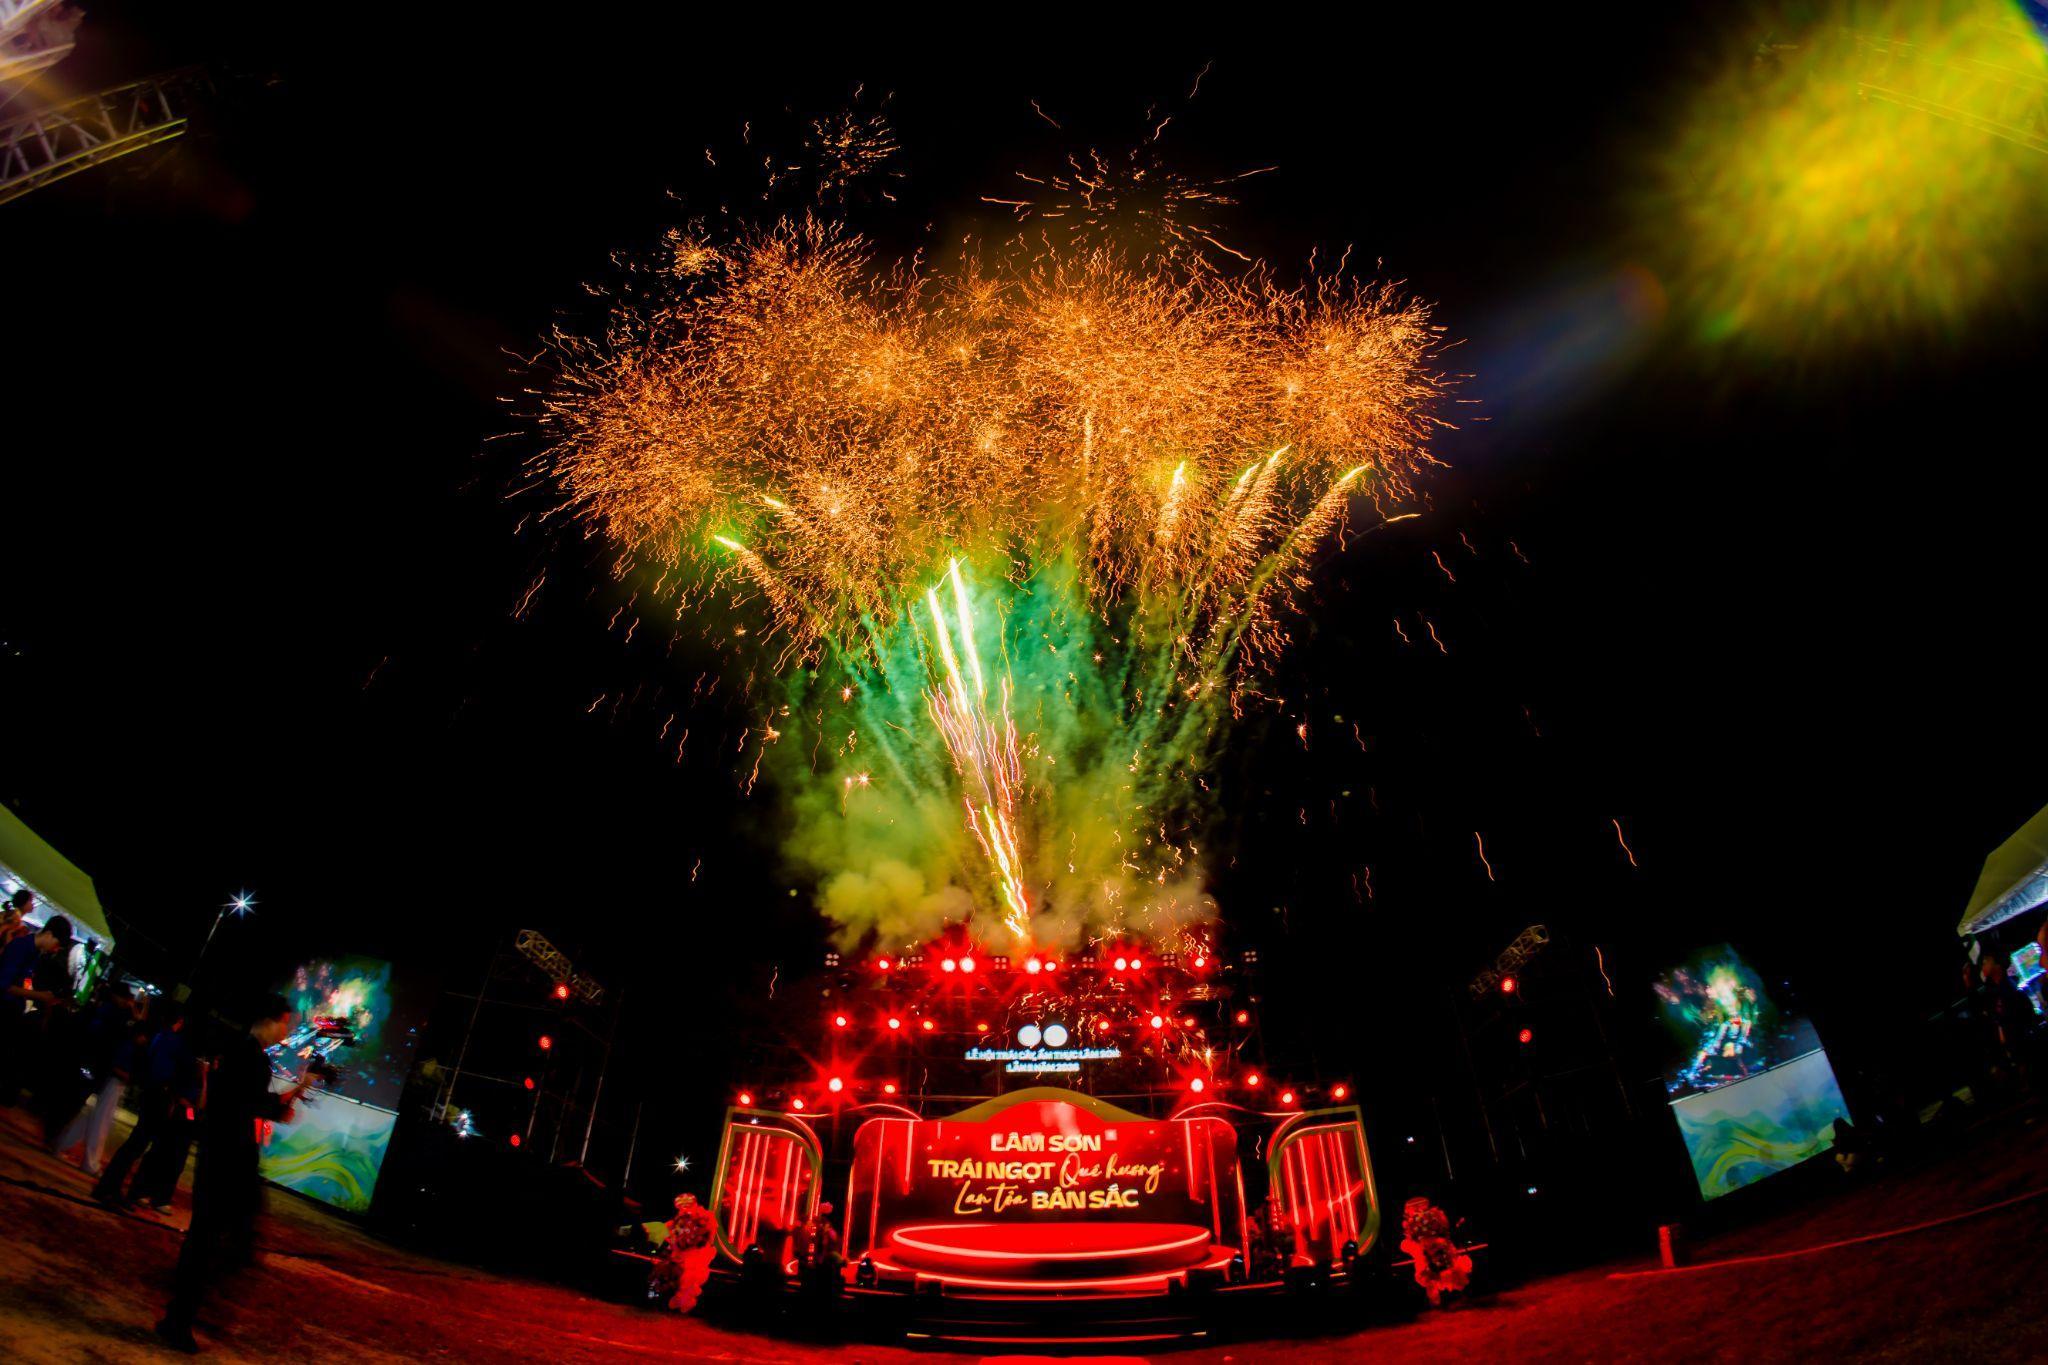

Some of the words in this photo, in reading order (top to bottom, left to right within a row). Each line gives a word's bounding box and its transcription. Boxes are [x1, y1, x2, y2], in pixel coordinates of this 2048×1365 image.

[991, 1132, 1045, 1152] LÂM
[1048, 1133, 1101, 1152] SƠN
[928, 1158, 982, 1179] TRÁI
[985, 1161, 1056, 1183] NGỌT
[1060, 1152, 1102, 1188] Quê
[954, 1180, 991, 1215] Lan
[1032, 1186, 1087, 1209] BẢN
[1088, 1183, 1140, 1209] SẮC
